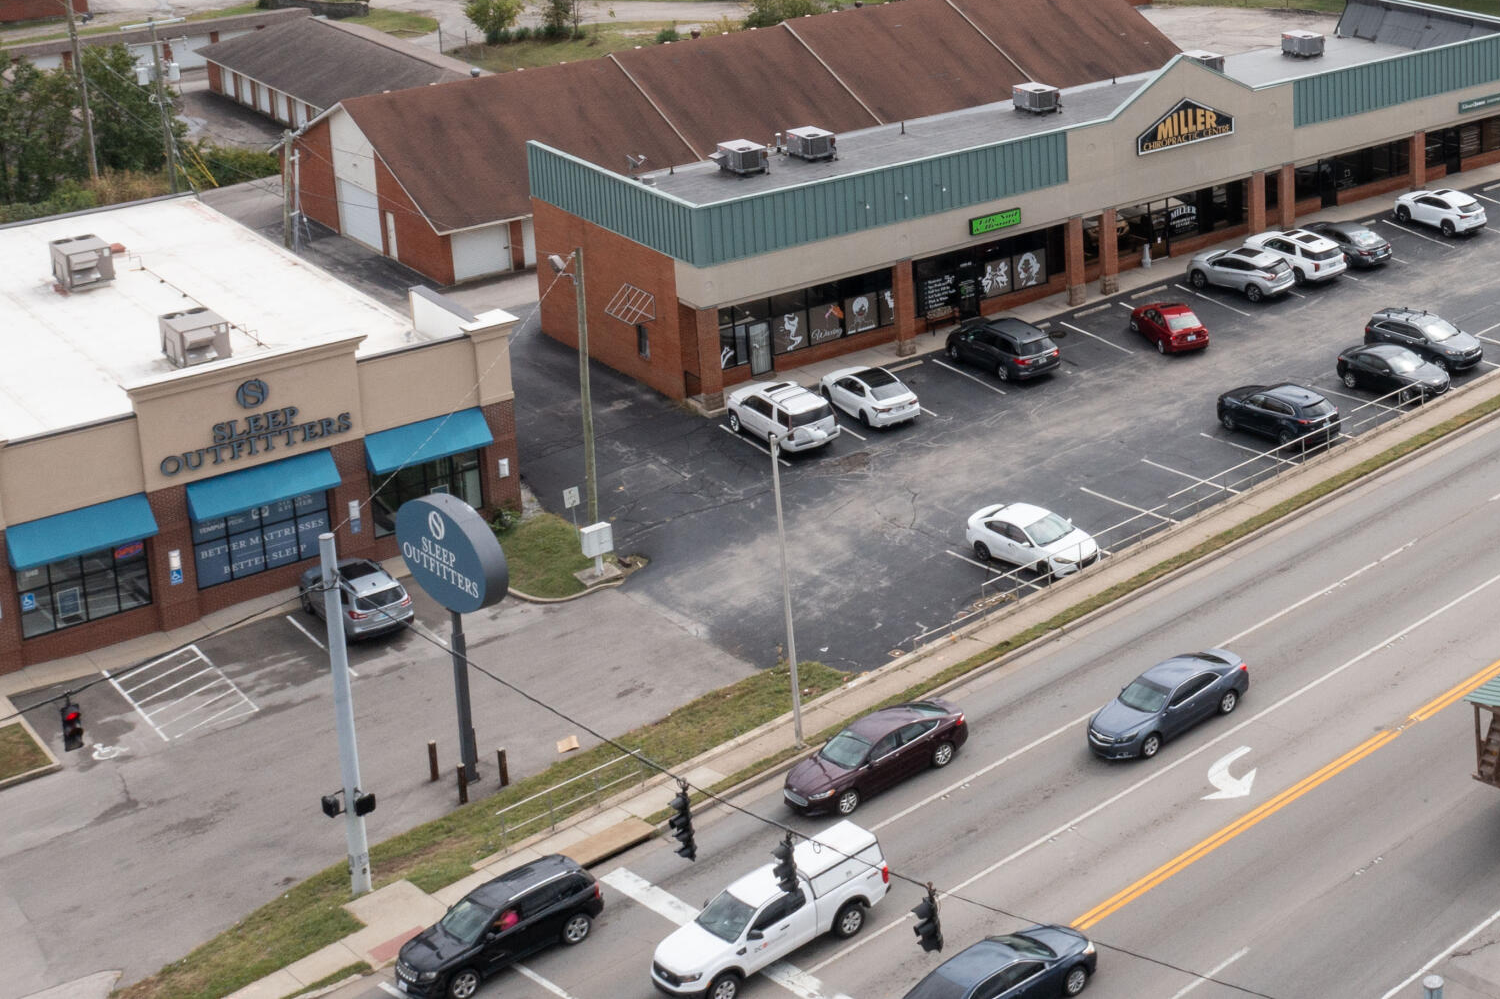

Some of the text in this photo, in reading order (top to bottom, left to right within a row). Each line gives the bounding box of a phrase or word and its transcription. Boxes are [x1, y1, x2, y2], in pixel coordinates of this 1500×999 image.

[1143, 123, 1230, 151] CHIROPRACTIC CENTRE
[1156, 107, 1217, 141] MILLER
[1170, 205, 1197, 220] MILLER
[212, 405, 299, 444] SLEEP
[159, 411, 353, 477] OUTFITTERS
[200, 539, 247, 560] BETTER
[421, 536, 456, 567] SLEEP
[403, 541, 479, 600] OUTFITTERS
